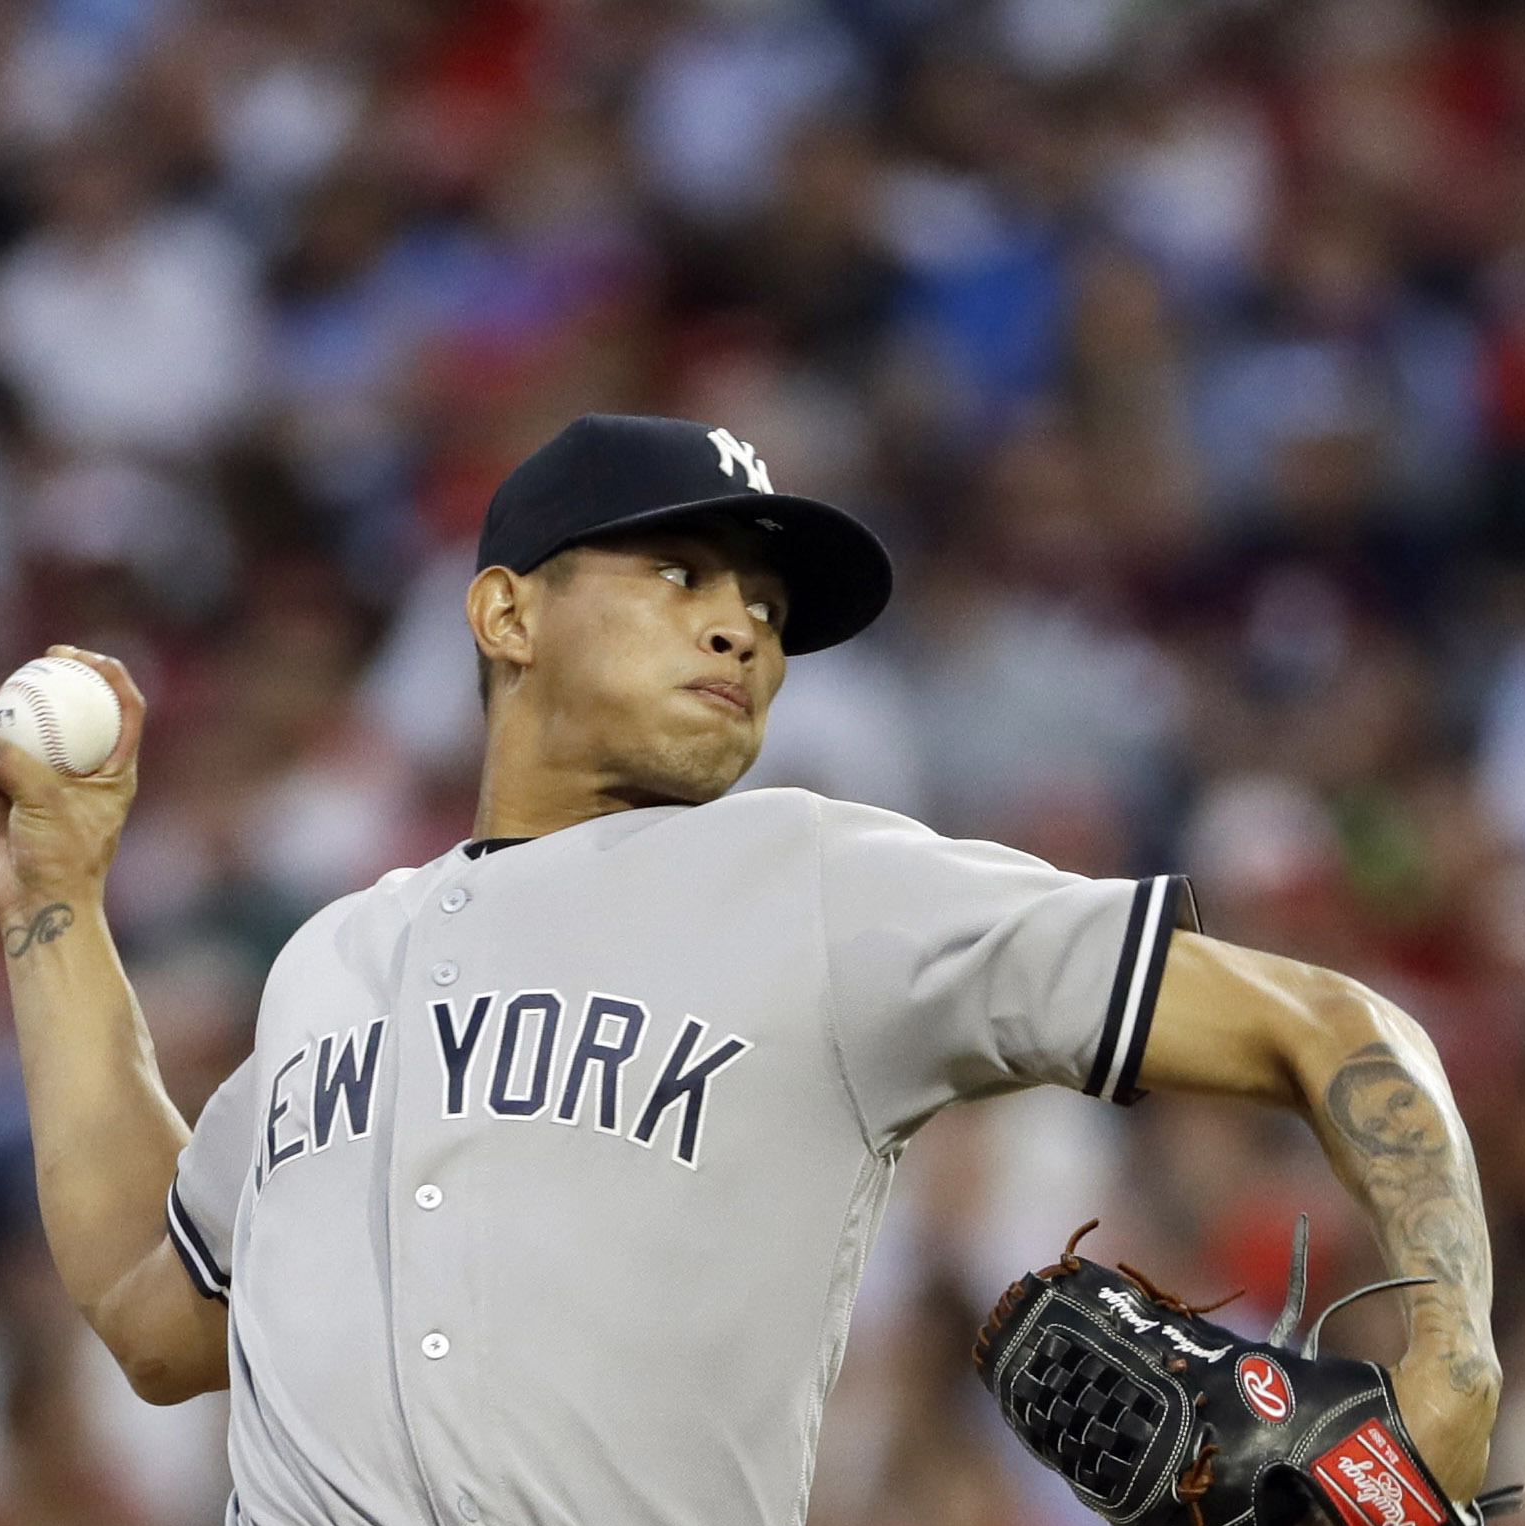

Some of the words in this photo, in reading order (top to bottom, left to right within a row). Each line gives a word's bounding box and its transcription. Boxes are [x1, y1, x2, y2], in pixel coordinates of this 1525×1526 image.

[255, 1015, 389, 1200] EW
[427, 988, 755, 1171] YORK
[1243, 1365, 1287, 1418] R
